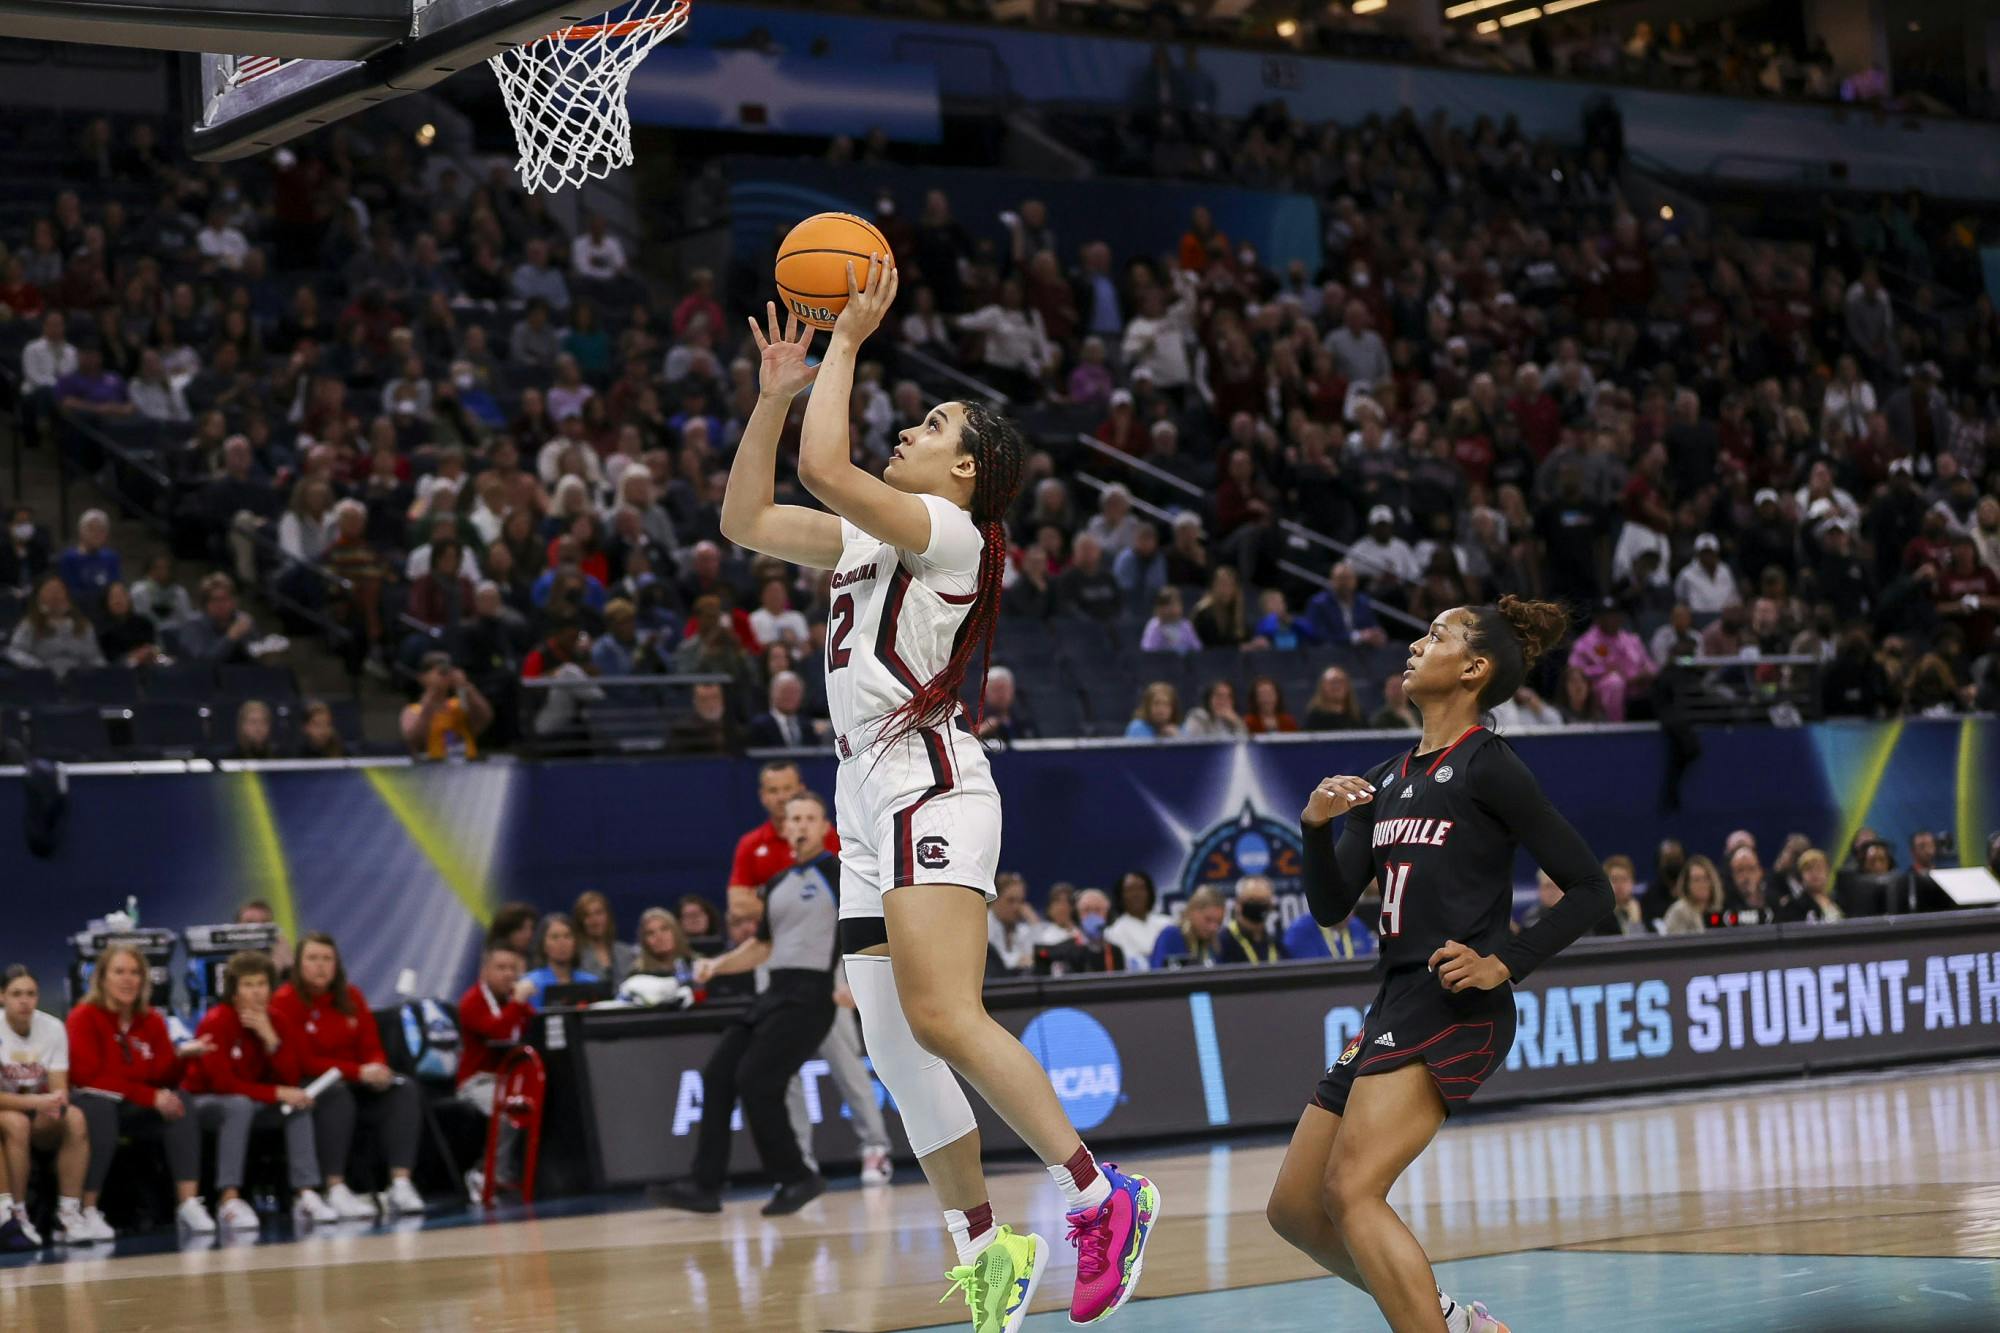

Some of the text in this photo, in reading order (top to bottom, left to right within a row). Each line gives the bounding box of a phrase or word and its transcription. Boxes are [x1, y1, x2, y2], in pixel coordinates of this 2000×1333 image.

[789, 298, 838, 322] Wils
[828, 592, 854, 674] 2
[1371, 817, 1453, 849] OUISVILLE
[1379, 862, 1412, 936] 4
[1324, 980, 1673, 1071] CRATES
[1048, 1063, 1120, 1098] CAA
